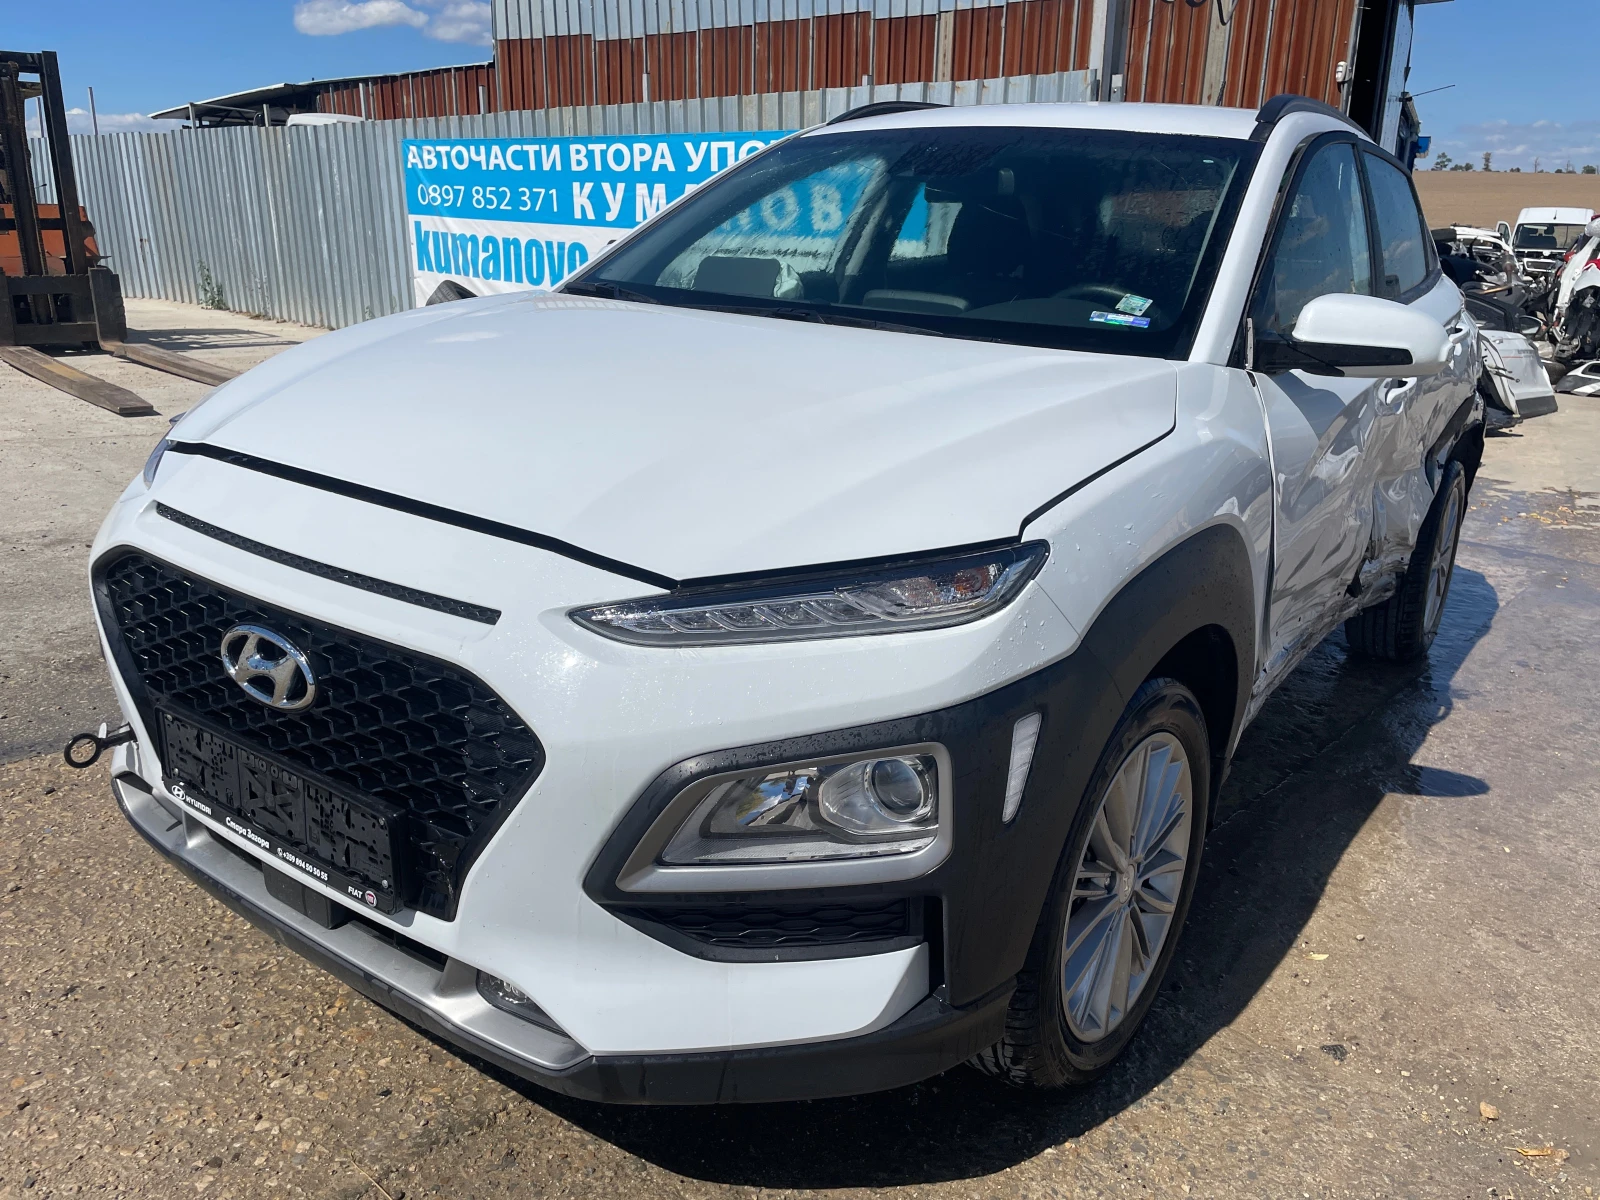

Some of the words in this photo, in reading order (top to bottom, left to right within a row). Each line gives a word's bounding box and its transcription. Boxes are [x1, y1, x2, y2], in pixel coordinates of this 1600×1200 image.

[407, 144, 562, 171] АВТОЧАСТИ
[569, 142, 676, 172] ВТОРА
[417, 183, 465, 208] 0897
[472, 186, 512, 210] 852
[518, 187, 558, 213] 371
[185, 795, 212, 816] HYUNDAI
[347, 885, 363, 899] FIAT
